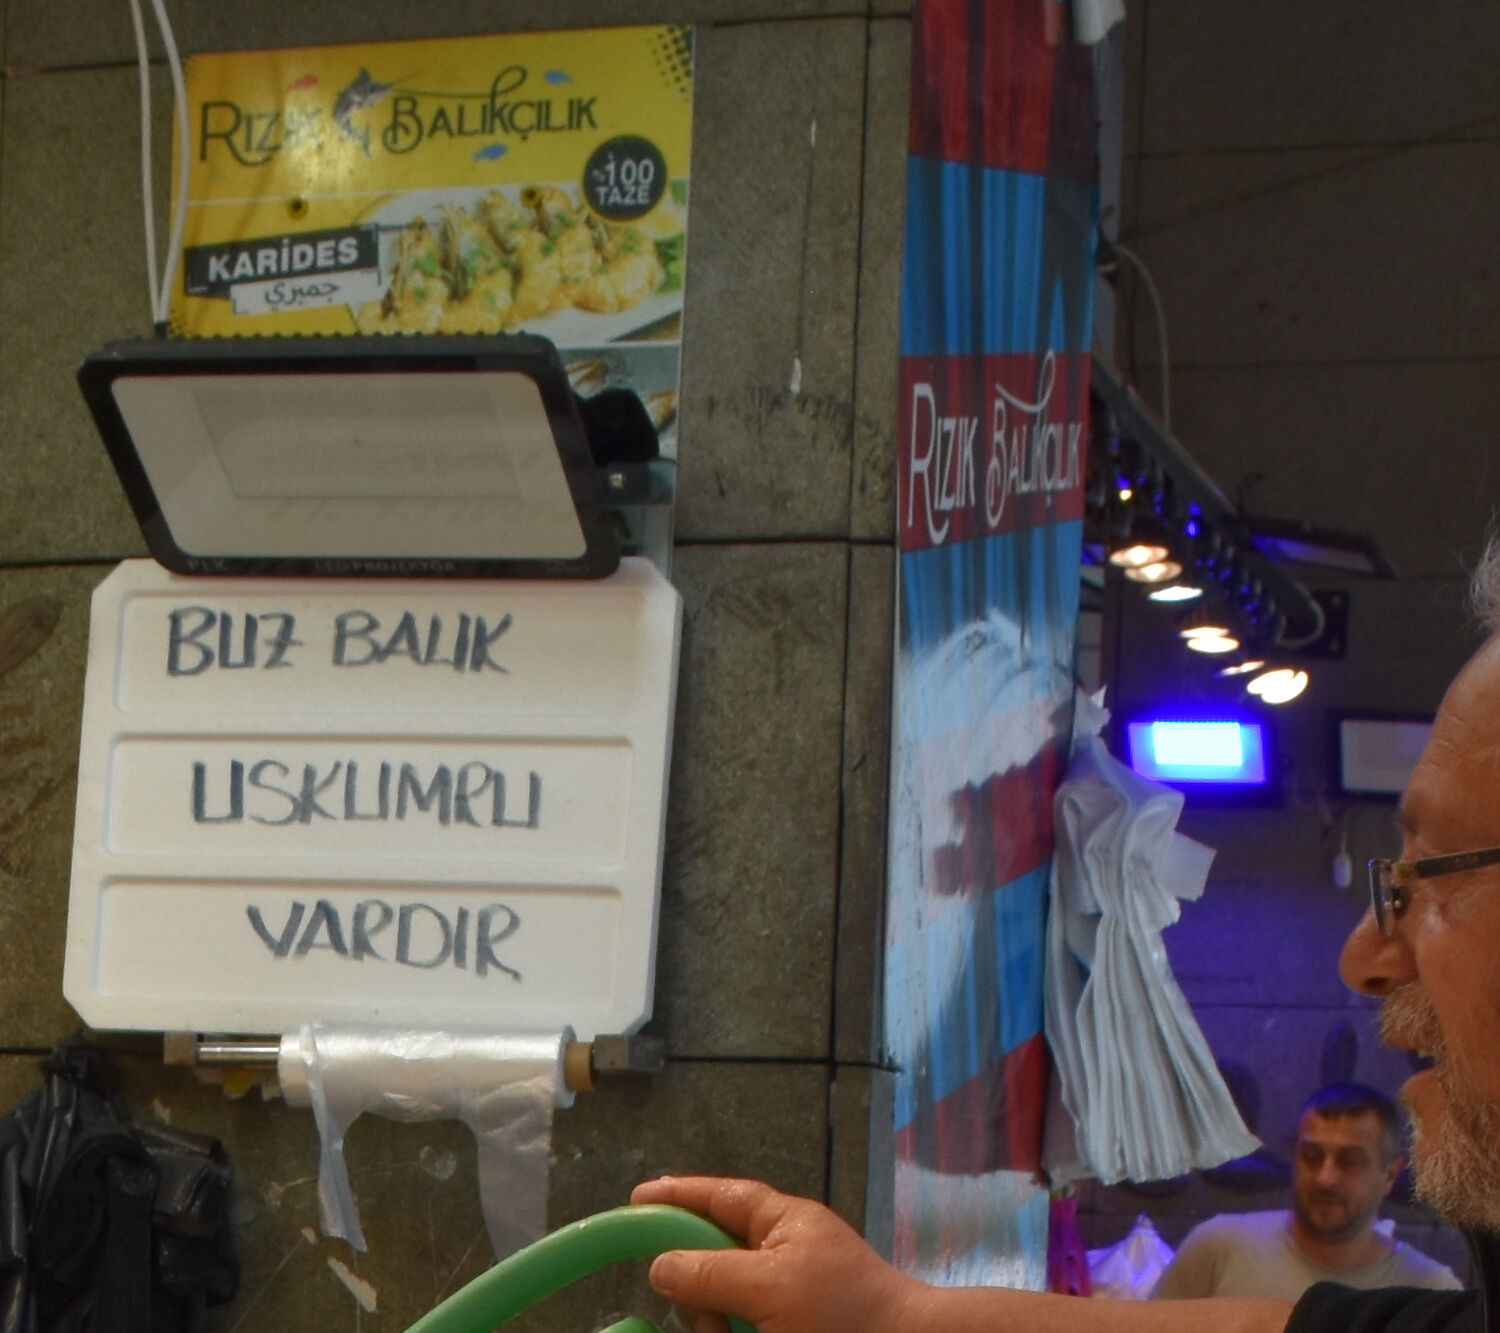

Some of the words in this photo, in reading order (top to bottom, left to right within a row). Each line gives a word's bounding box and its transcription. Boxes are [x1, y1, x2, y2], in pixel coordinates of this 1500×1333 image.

[383, 66, 601, 154] BALIKÇILIK
[595, 186, 651, 207] TAZE
[206, 236, 360, 283] KARİDES
[908, 381, 978, 546] RIZIK
[986, 348, 1083, 528] BALIKÇILIK
[167, 606, 304, 676] BUZ
[332, 609, 513, 675] BALIK
[192, 758, 542, 830] USKUMRU
[246, 899, 523, 983] VARDIR
